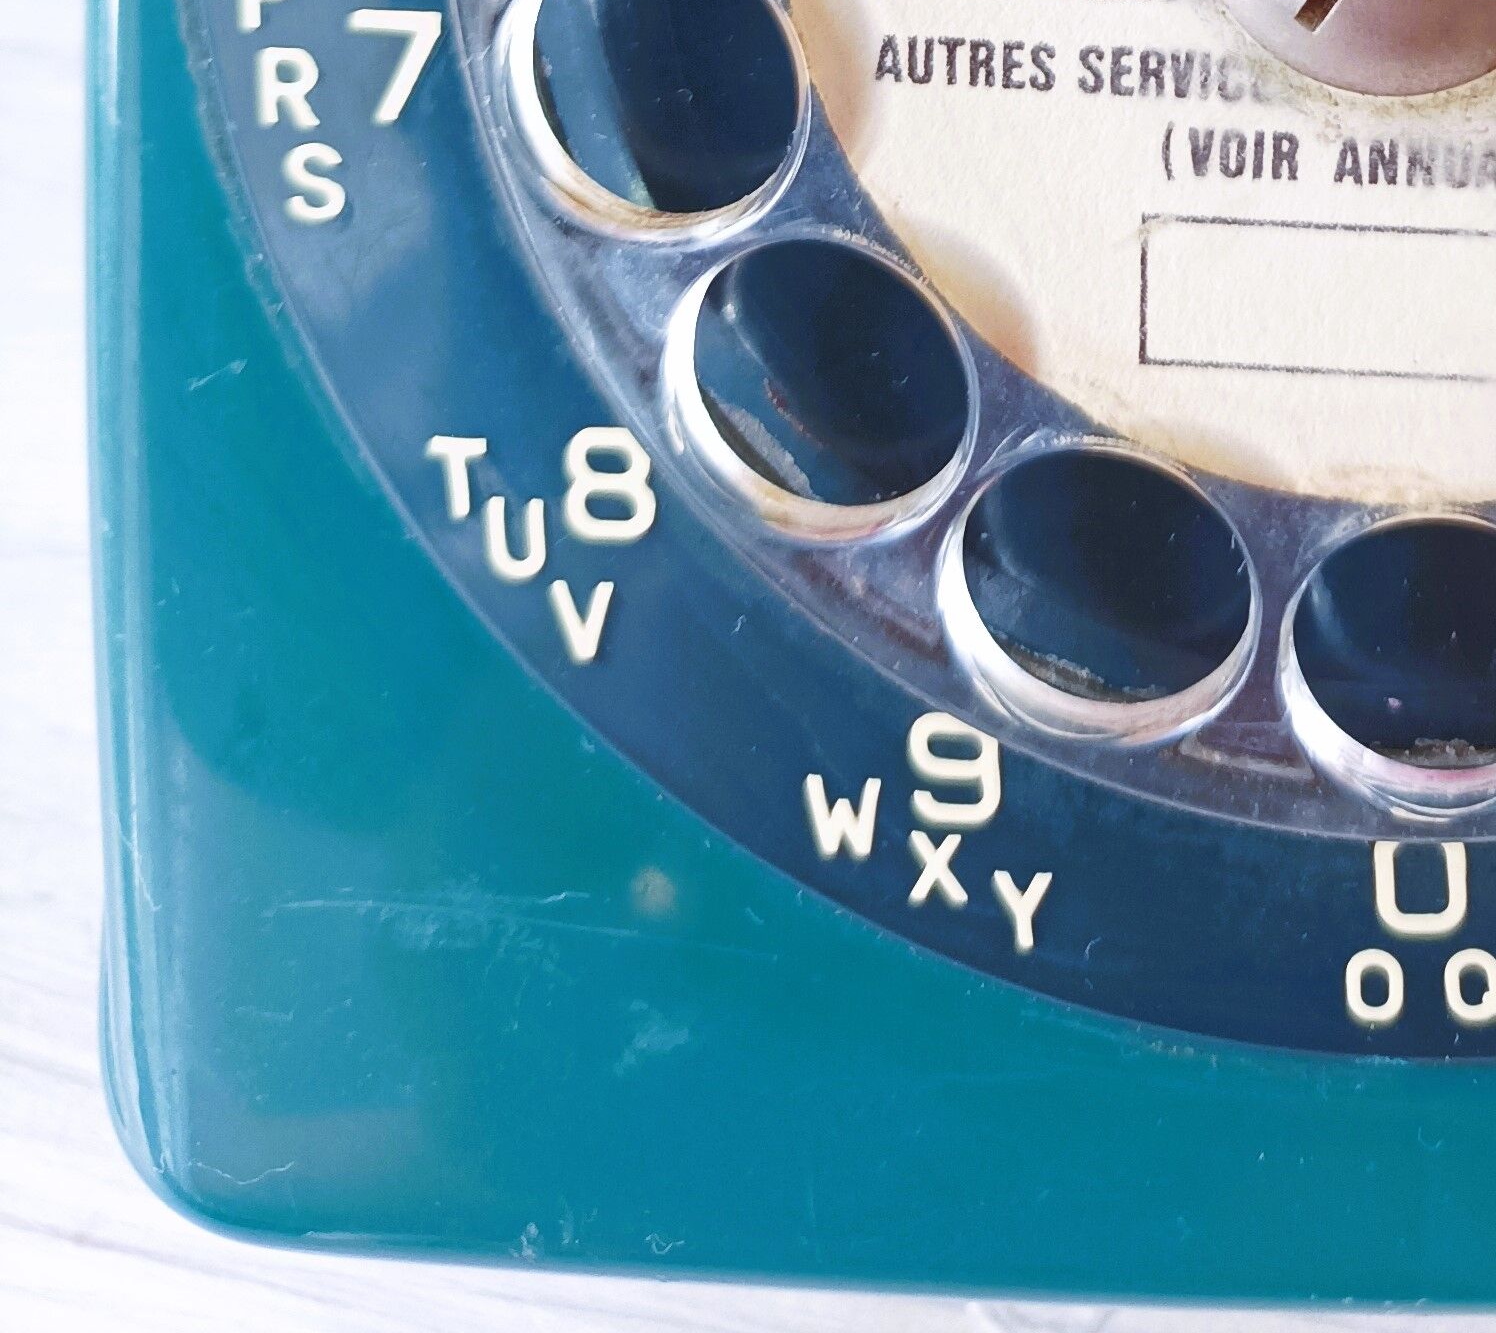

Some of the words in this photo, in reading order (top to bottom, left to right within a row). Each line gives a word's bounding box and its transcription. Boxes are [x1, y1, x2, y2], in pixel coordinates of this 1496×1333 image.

[346, 8, 443, 127] 7
[875, 33, 1057, 93] AUTRES
[1077, 42, 1272, 103] SERVIC
[1161, 121, 1299, 181] (VOIR
[563, 426, 656, 544] 8
[907, 711, 1001, 827] 9
